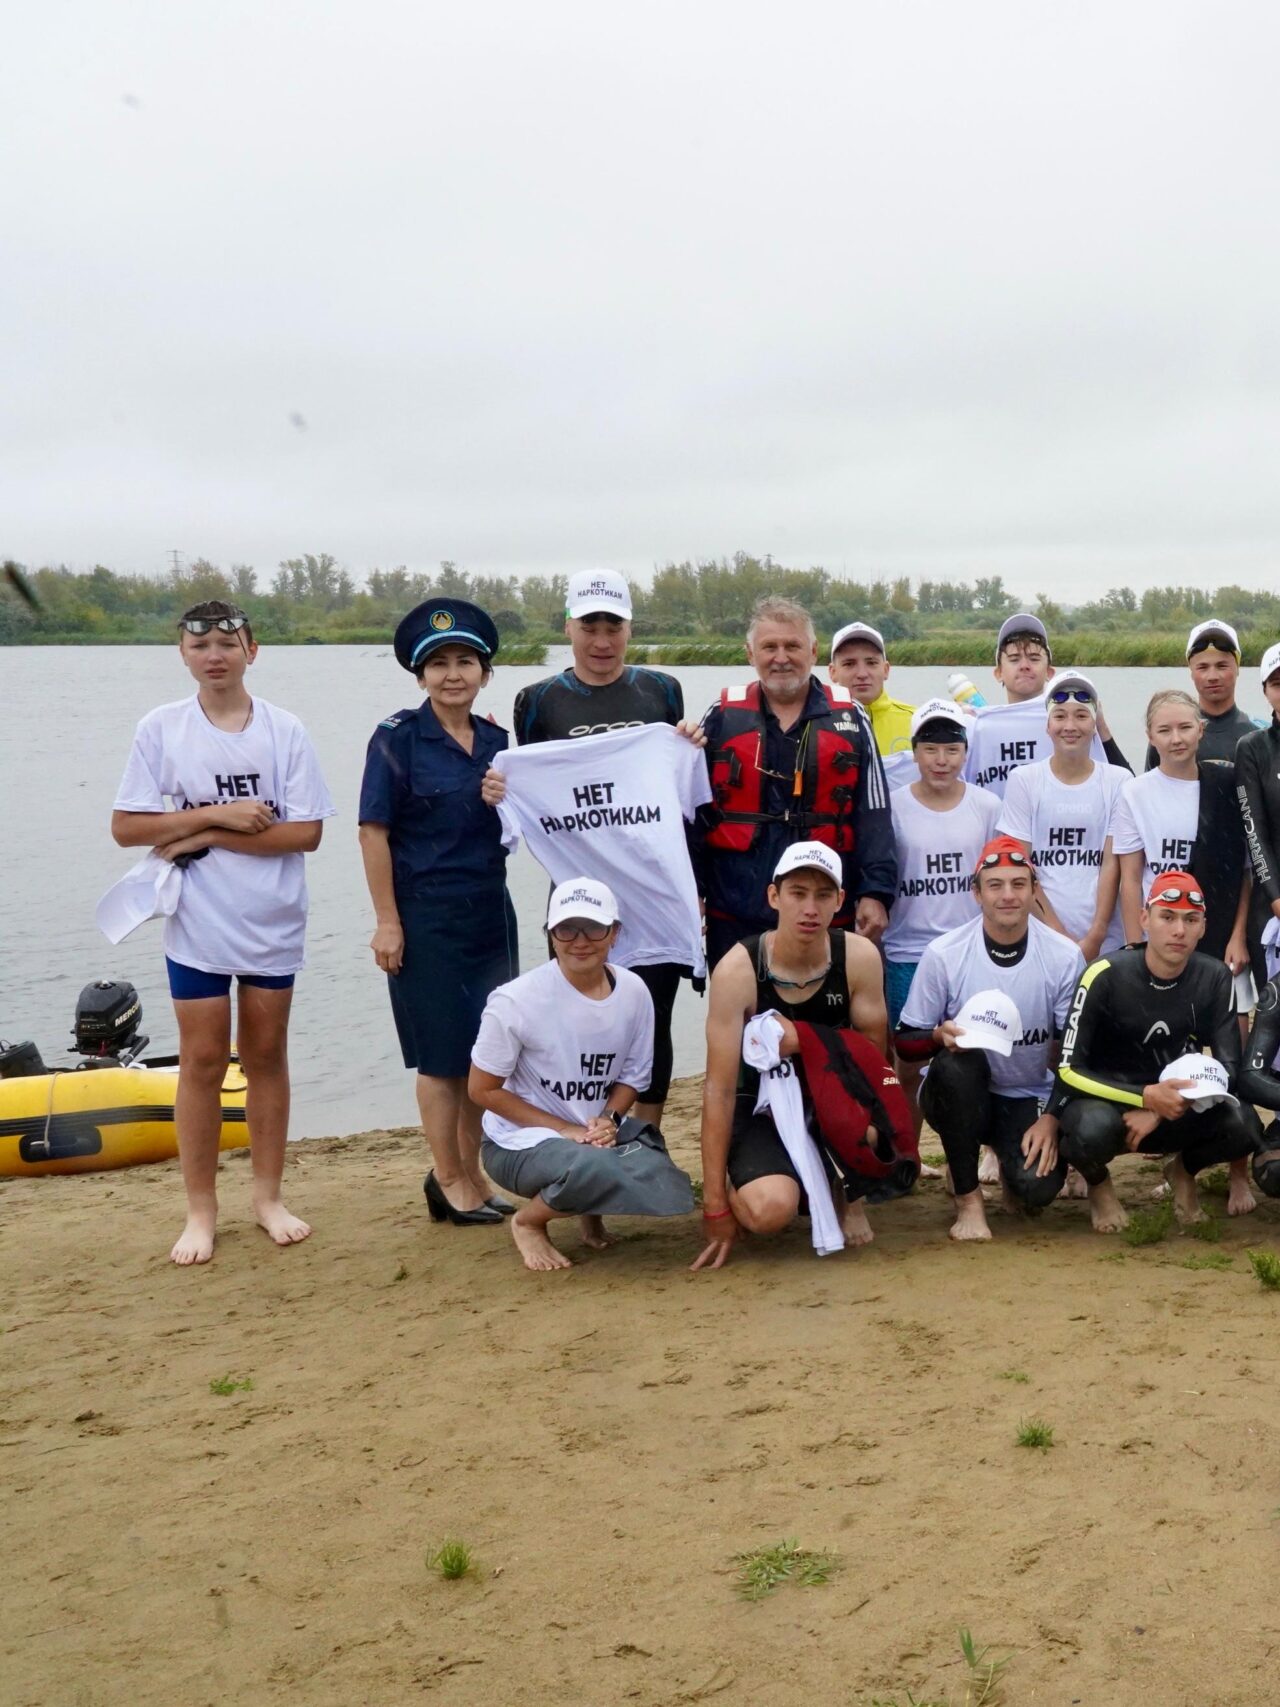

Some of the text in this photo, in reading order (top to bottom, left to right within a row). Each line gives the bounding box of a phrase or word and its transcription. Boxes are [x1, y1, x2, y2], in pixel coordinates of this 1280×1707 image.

[577, 588, 623, 599] НАРКОТИКАМ
[1000, 741, 1037, 762] НЕТ
[215, 773, 260, 797] НЕТ
[573, 782, 615, 808] НЕТ
[1049, 827, 1087, 846] НЕТ
[926, 852, 963, 874] НЕТ
[991, 949, 1018, 959] HEAD
[826, 993, 844, 1005] TYR
[971, 1015, 1008, 1031] НАРКОТИКАМ
[985, 1010, 999, 1018] НЕТ
[1058, 986, 1089, 1068] HEAD
[580, 1053, 616, 1077] НЕТ
[1204, 1066, 1219, 1074] НЕТ
